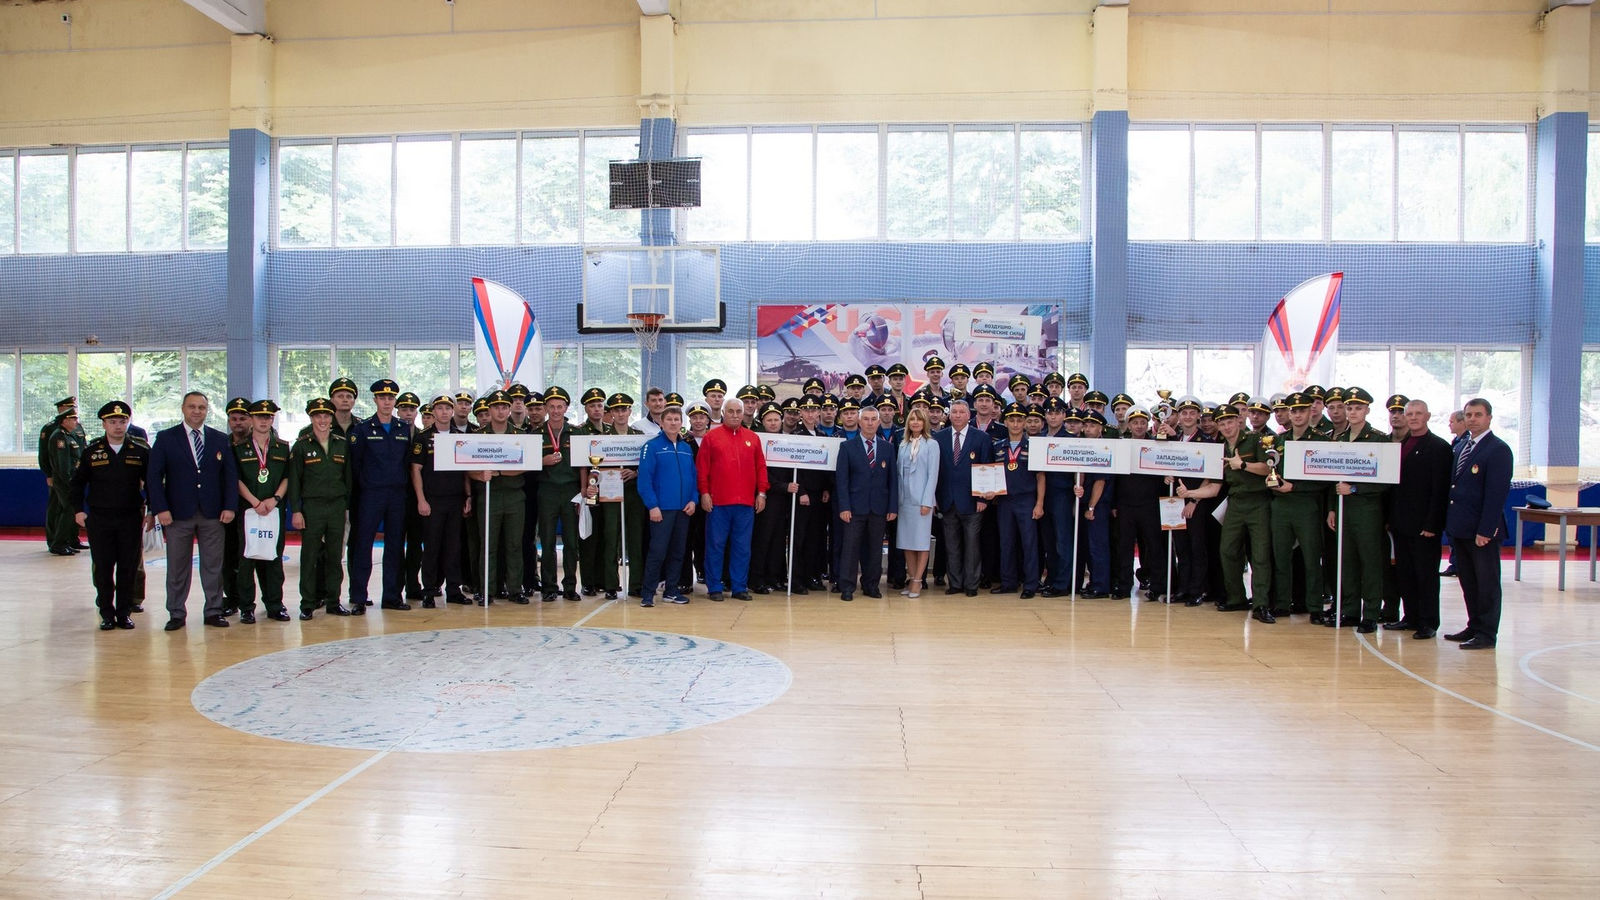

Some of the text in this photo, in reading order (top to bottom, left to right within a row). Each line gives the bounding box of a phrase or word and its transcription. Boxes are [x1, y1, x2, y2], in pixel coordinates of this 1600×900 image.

[773, 447, 823, 455] ВОЕННО-МОРСКОЙ
[1345, 457, 1371, 465] ВОЙСКА
[258, 530, 274, 539] ВТБ
